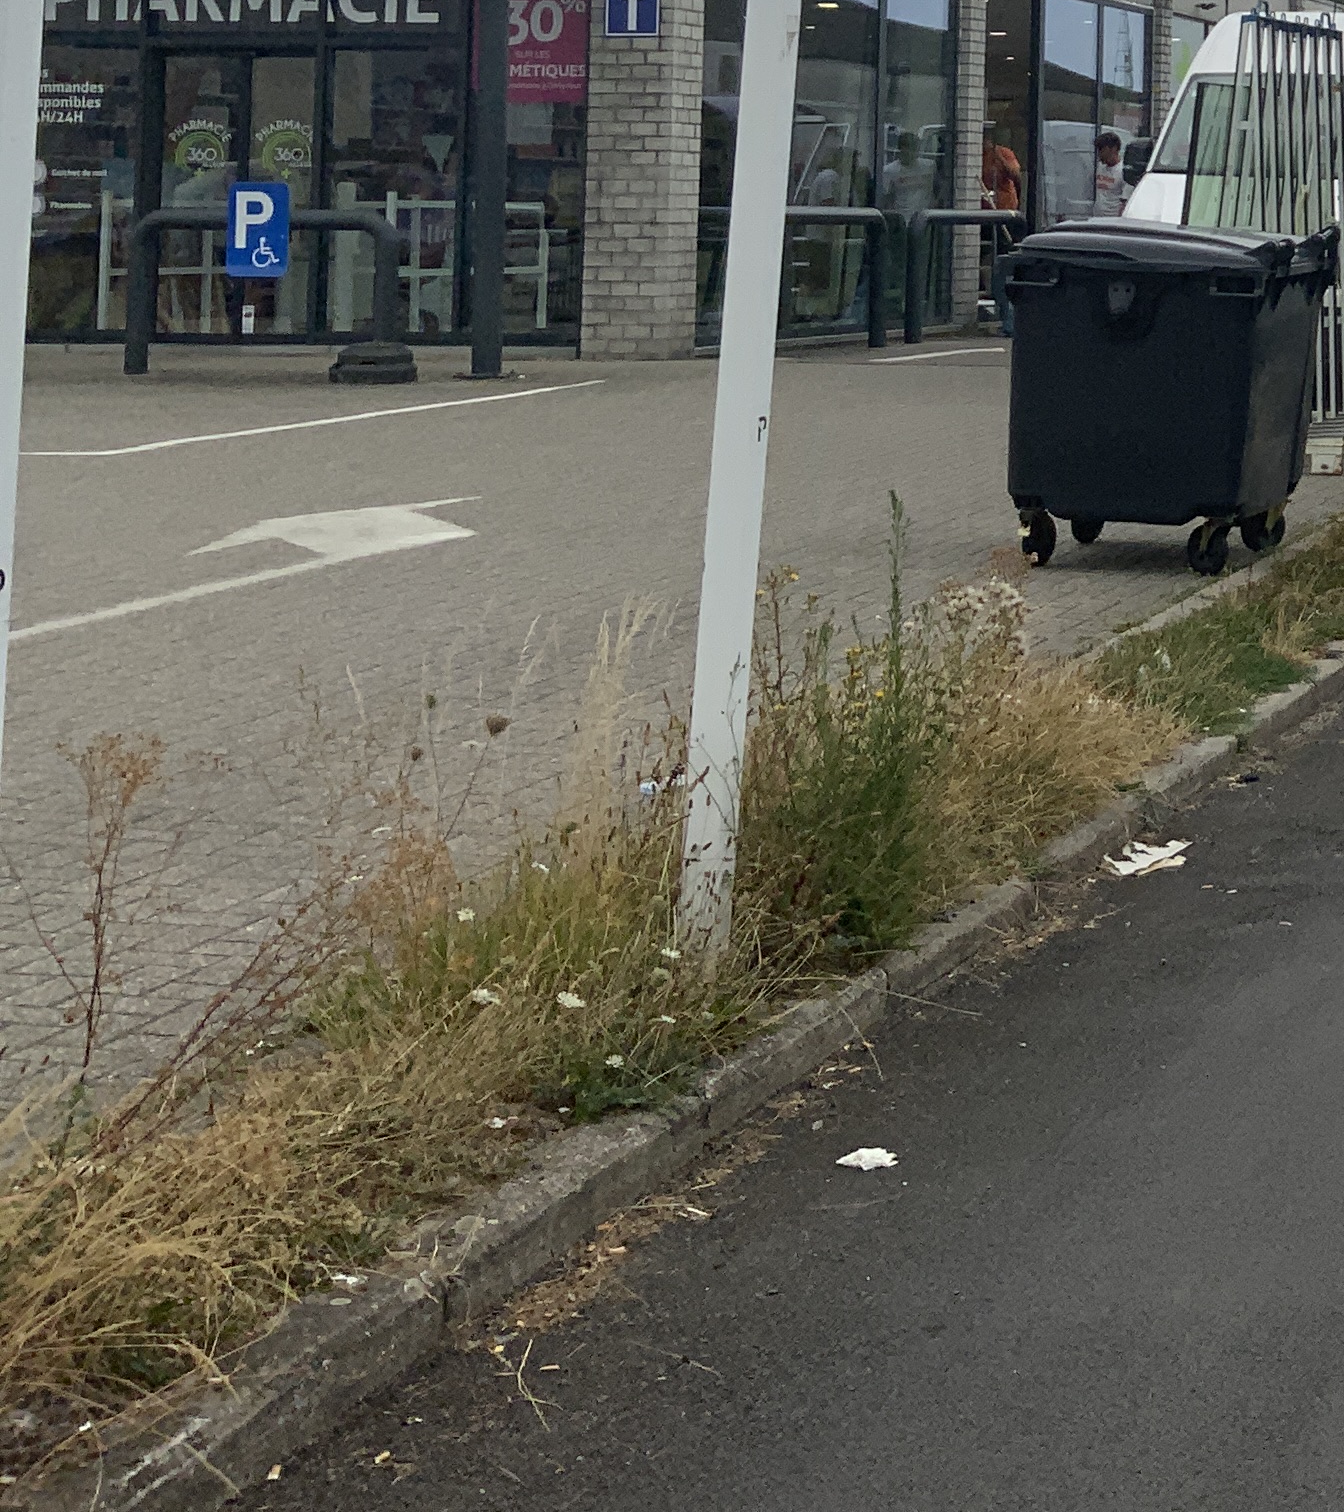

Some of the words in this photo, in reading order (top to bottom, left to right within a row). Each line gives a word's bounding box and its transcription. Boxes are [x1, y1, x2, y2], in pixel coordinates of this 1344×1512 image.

[38, 110, 84, 124] H/24H
[168, 119, 232, 143] PHARMACIE
[255, 119, 314, 143] PHARMACI
[187, 147, 217, 161] 360
[273, 147, 304, 161] 360
[234, 191, 274, 249] P
